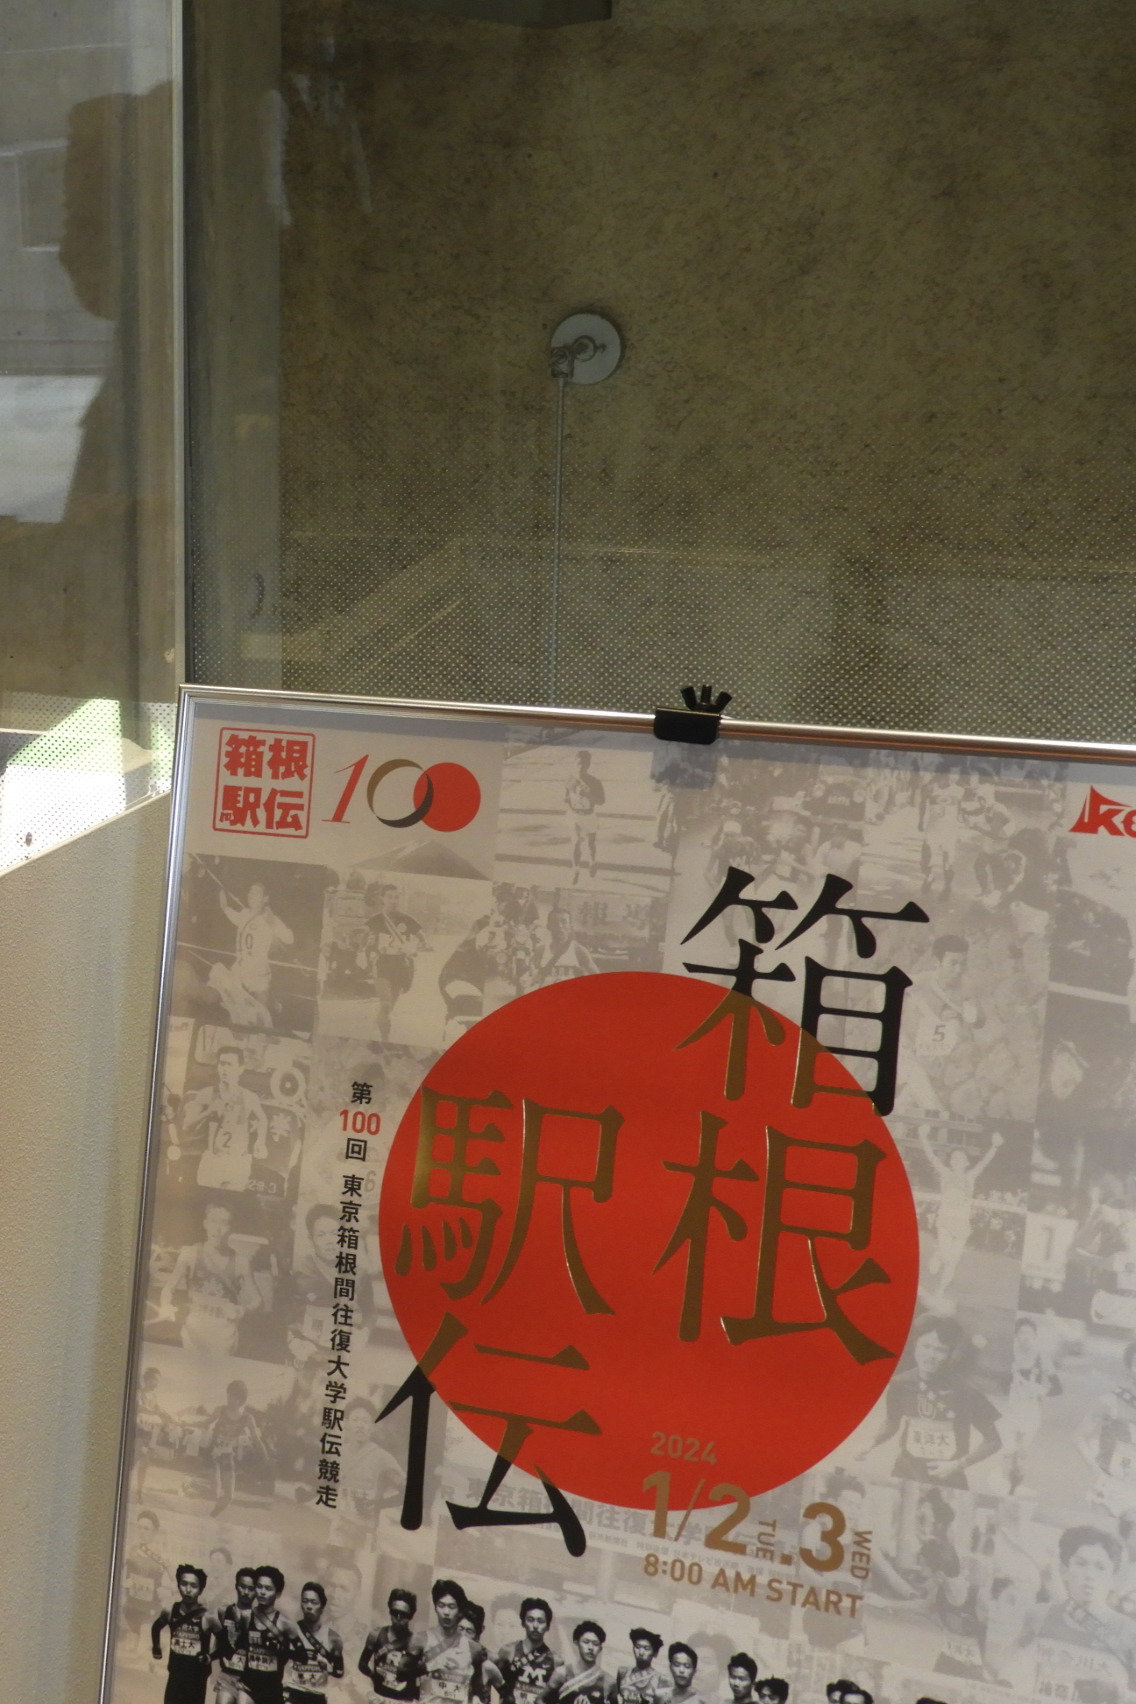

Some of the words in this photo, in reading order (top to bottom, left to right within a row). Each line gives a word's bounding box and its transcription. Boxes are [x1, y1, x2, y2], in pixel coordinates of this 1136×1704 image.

[223, 734, 310, 782] 箱根
[220, 785, 306, 831] 駅伝
[931, 1024, 946, 1042] 5
[652, 866, 930, 1365] 箱根
[316, 1174, 364, 1509] 東京箱根間往復大学駅伝競走
[374, 1084, 625, 1558] 駅伝
[650, 1431, 718, 1464] 2024
[755, 1520, 776, 1562] TUE
[850, 1530, 872, 1580] WED
[644, 1553, 703, 1586] 8:00
[710, 1568, 758, 1598] AM
[766, 1578, 864, 1618] START
